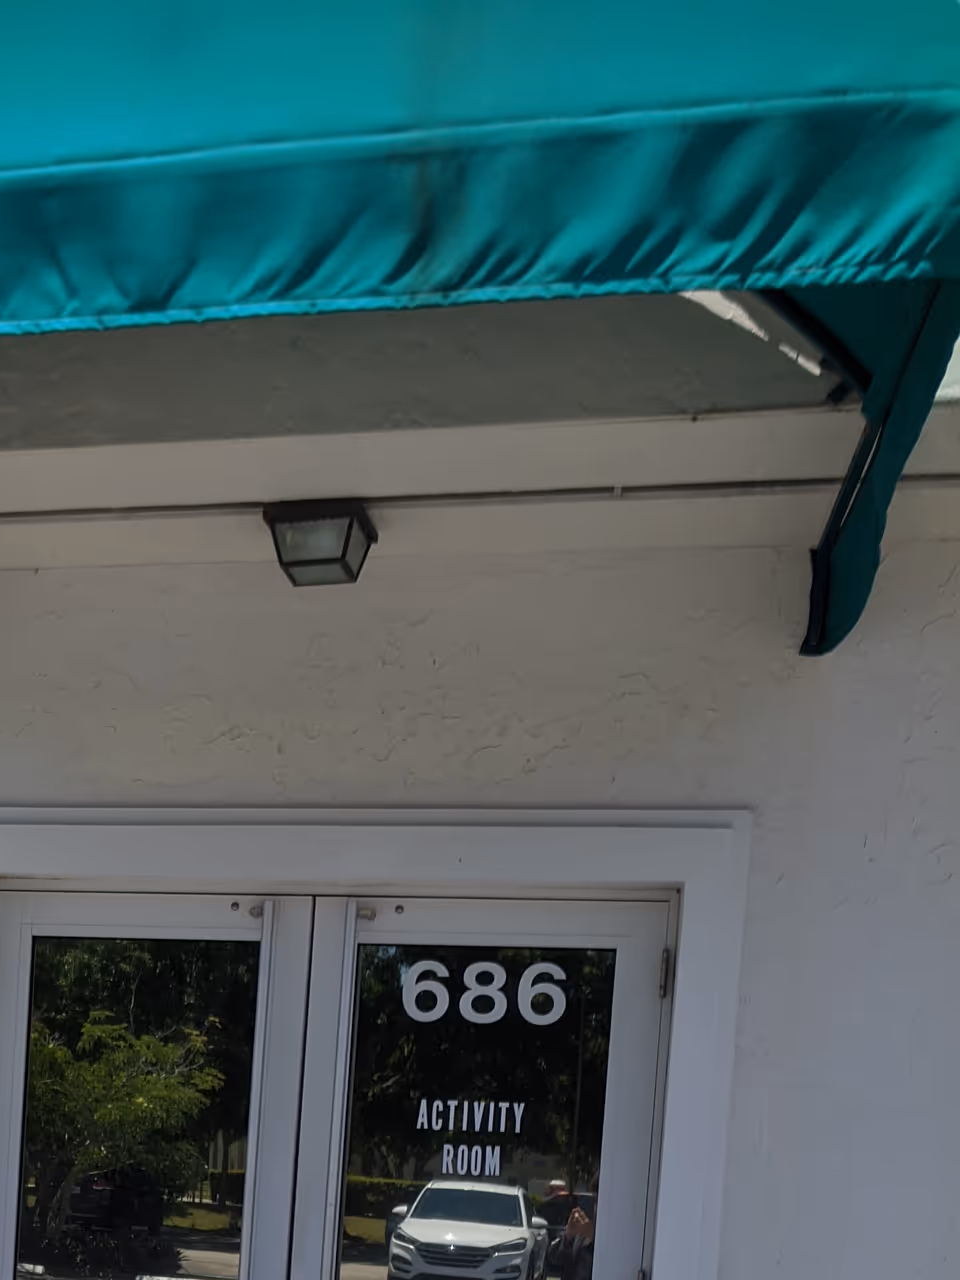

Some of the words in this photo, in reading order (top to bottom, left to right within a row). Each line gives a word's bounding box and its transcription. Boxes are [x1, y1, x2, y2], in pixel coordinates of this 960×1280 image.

[402, 960, 567, 1026] 686
[416, 1098, 526, 1134] ACTIVITY
[442, 1144, 502, 1176] ROOM
